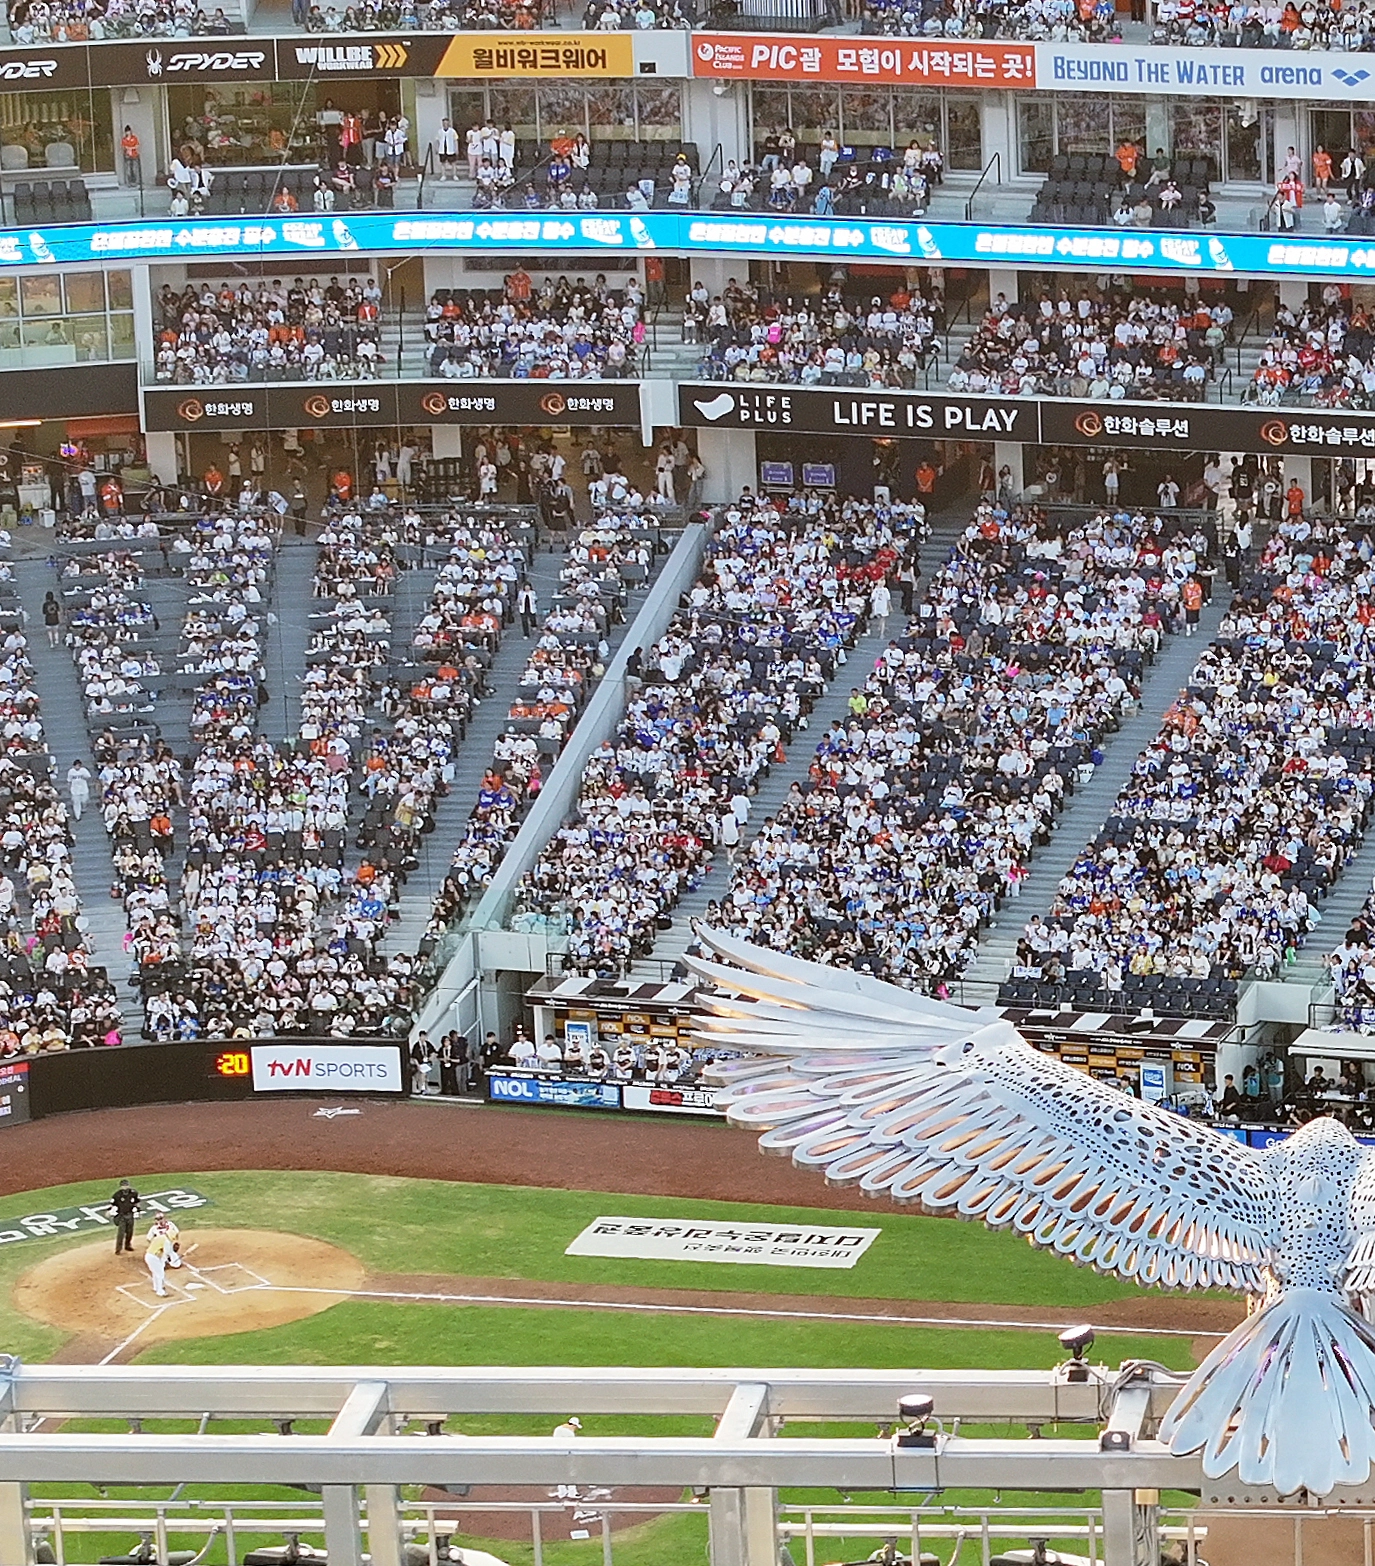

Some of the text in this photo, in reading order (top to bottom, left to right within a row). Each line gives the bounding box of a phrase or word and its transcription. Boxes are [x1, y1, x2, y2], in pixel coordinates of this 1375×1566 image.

[166, 52, 265, 71] SPYDER
[295, 46, 373, 64] WILLBE
[472, 48, 608, 69] 윌비워크웨어
[836, 49, 901, 76] 모험이
[908, 52, 995, 79] 시작되는
[1001, 53, 1033, 79] 곳!
[1260, 65, 1322, 86] arena
[204, 402, 254, 417] 한화생명
[331, 398, 380, 413] 한화생명
[448, 396, 495, 411] 한화생명
[566, 397, 615, 412] 한화생명
[739, 394, 792, 409] LIFE
[740, 411, 792, 424] PLUS
[833, 401, 1018, 432] LIFE IS PLAY
[1103, 416, 1190, 438] 한화솔루션
[1289, 424, 1375, 447] 한화솔루션
[268, 1058, 388, 1079] tvN SPORTS
[1177, 1063, 1196, 1072] NOL
[493, 1080, 533, 1098] NOL
